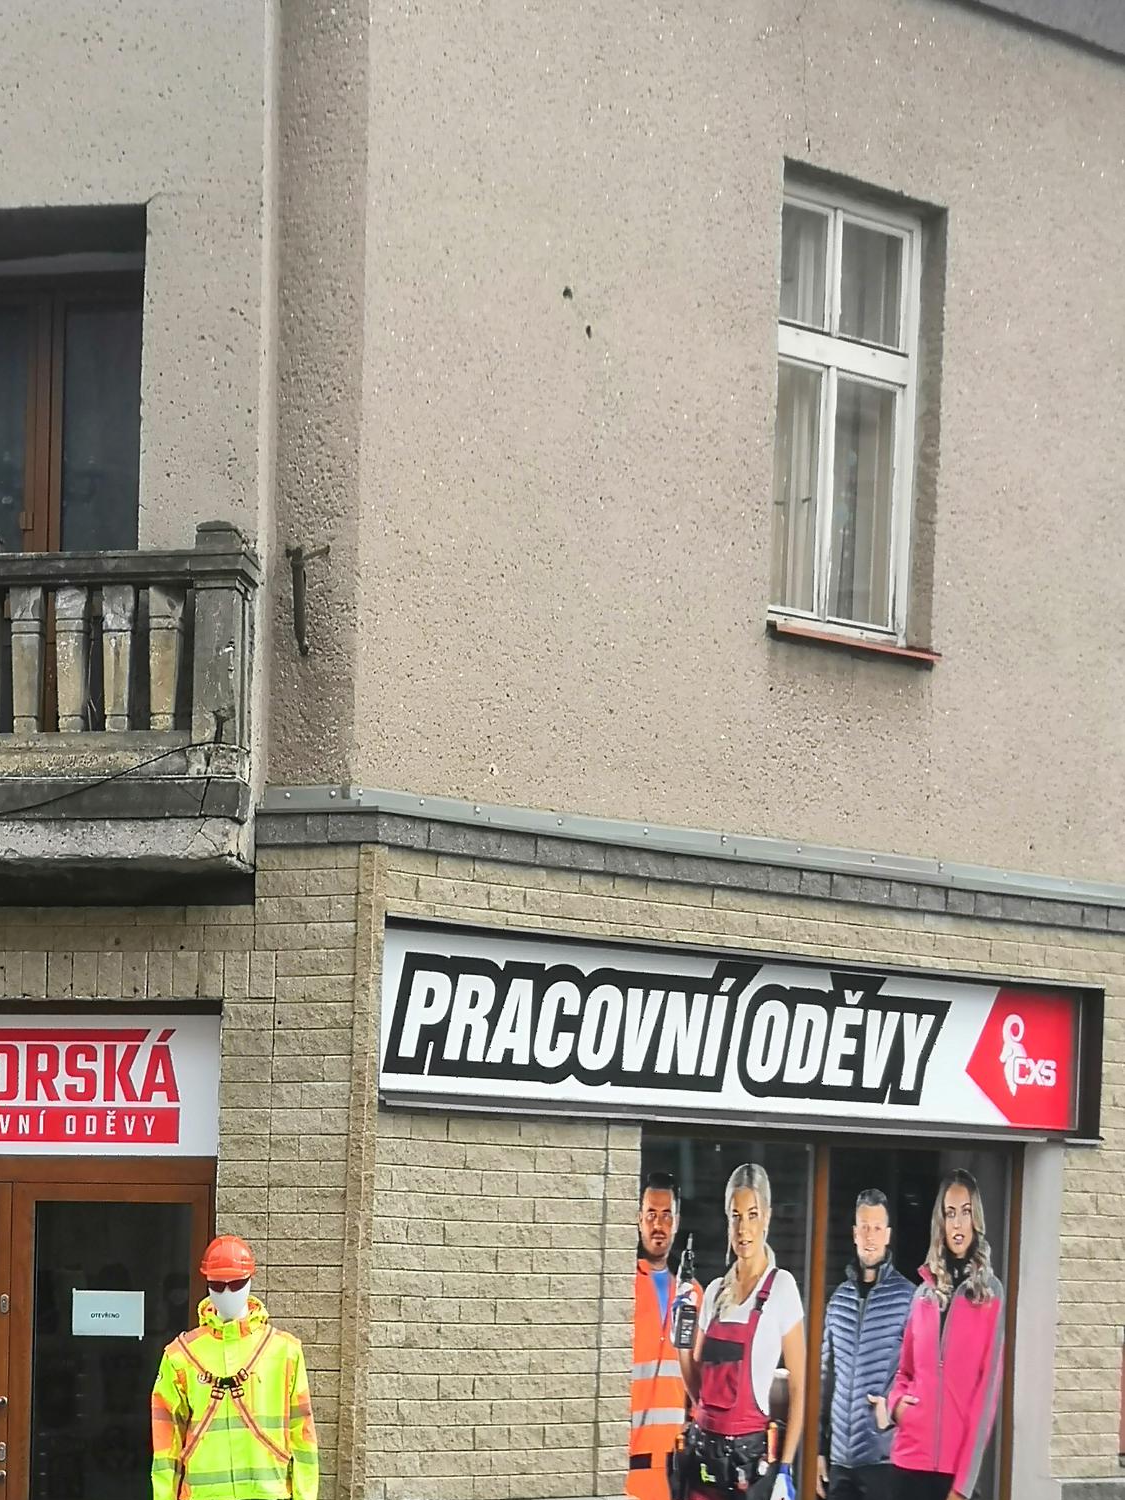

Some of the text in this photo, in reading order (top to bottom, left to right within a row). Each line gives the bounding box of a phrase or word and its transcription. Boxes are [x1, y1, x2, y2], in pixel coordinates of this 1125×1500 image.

[397, 968, 935, 1092] PRACOVNÍ ODĚVY
[1014, 1057, 1057, 1087] CXS
[64, 1110, 157, 1136] ODĚVY
